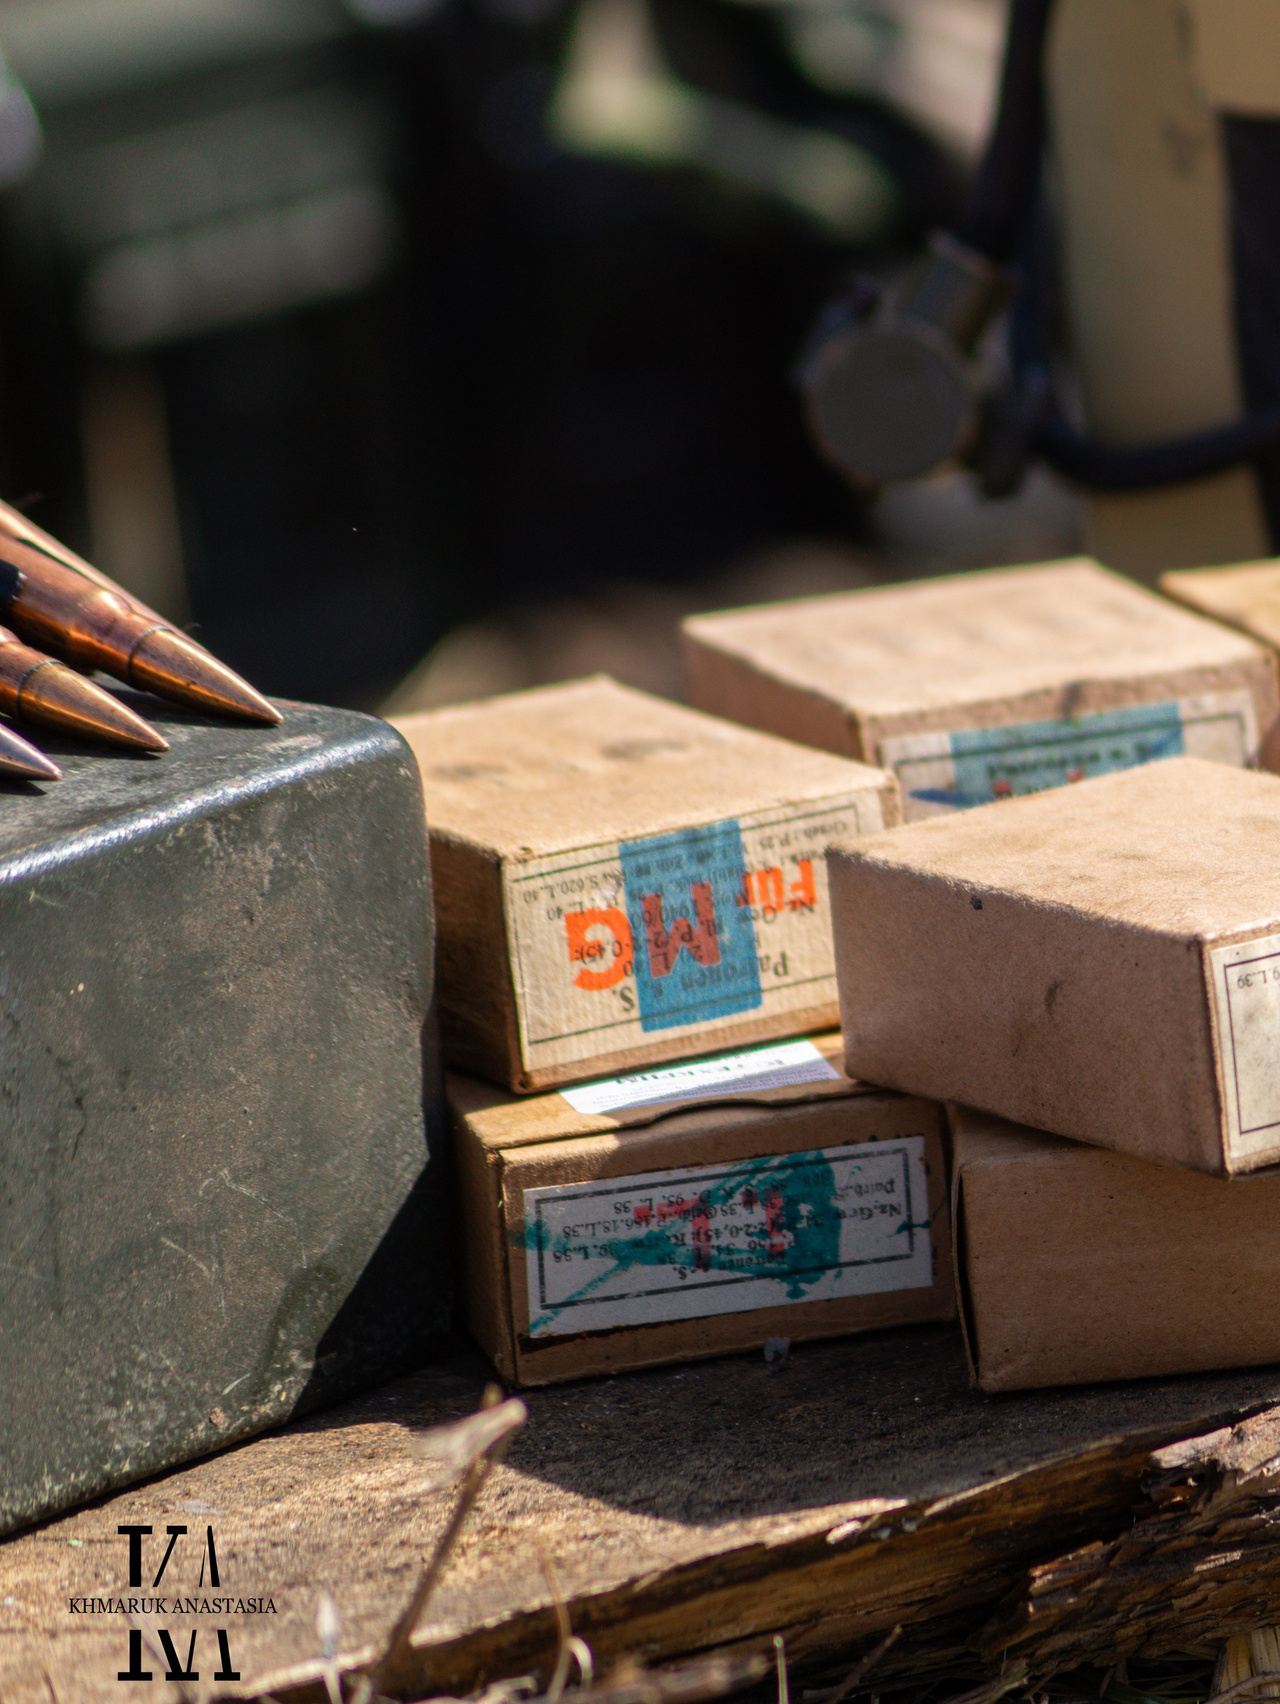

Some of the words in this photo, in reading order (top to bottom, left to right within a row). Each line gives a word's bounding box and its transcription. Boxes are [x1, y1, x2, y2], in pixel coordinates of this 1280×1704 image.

[736, 858, 817, 917] Für
[564, 882, 723, 992] MG
[612, 986, 635, 1012] S.
[613, 1200, 632, 1215] 38
[639, 1197, 653, 1213] L.
[672, 1266, 687, 1281] S.
